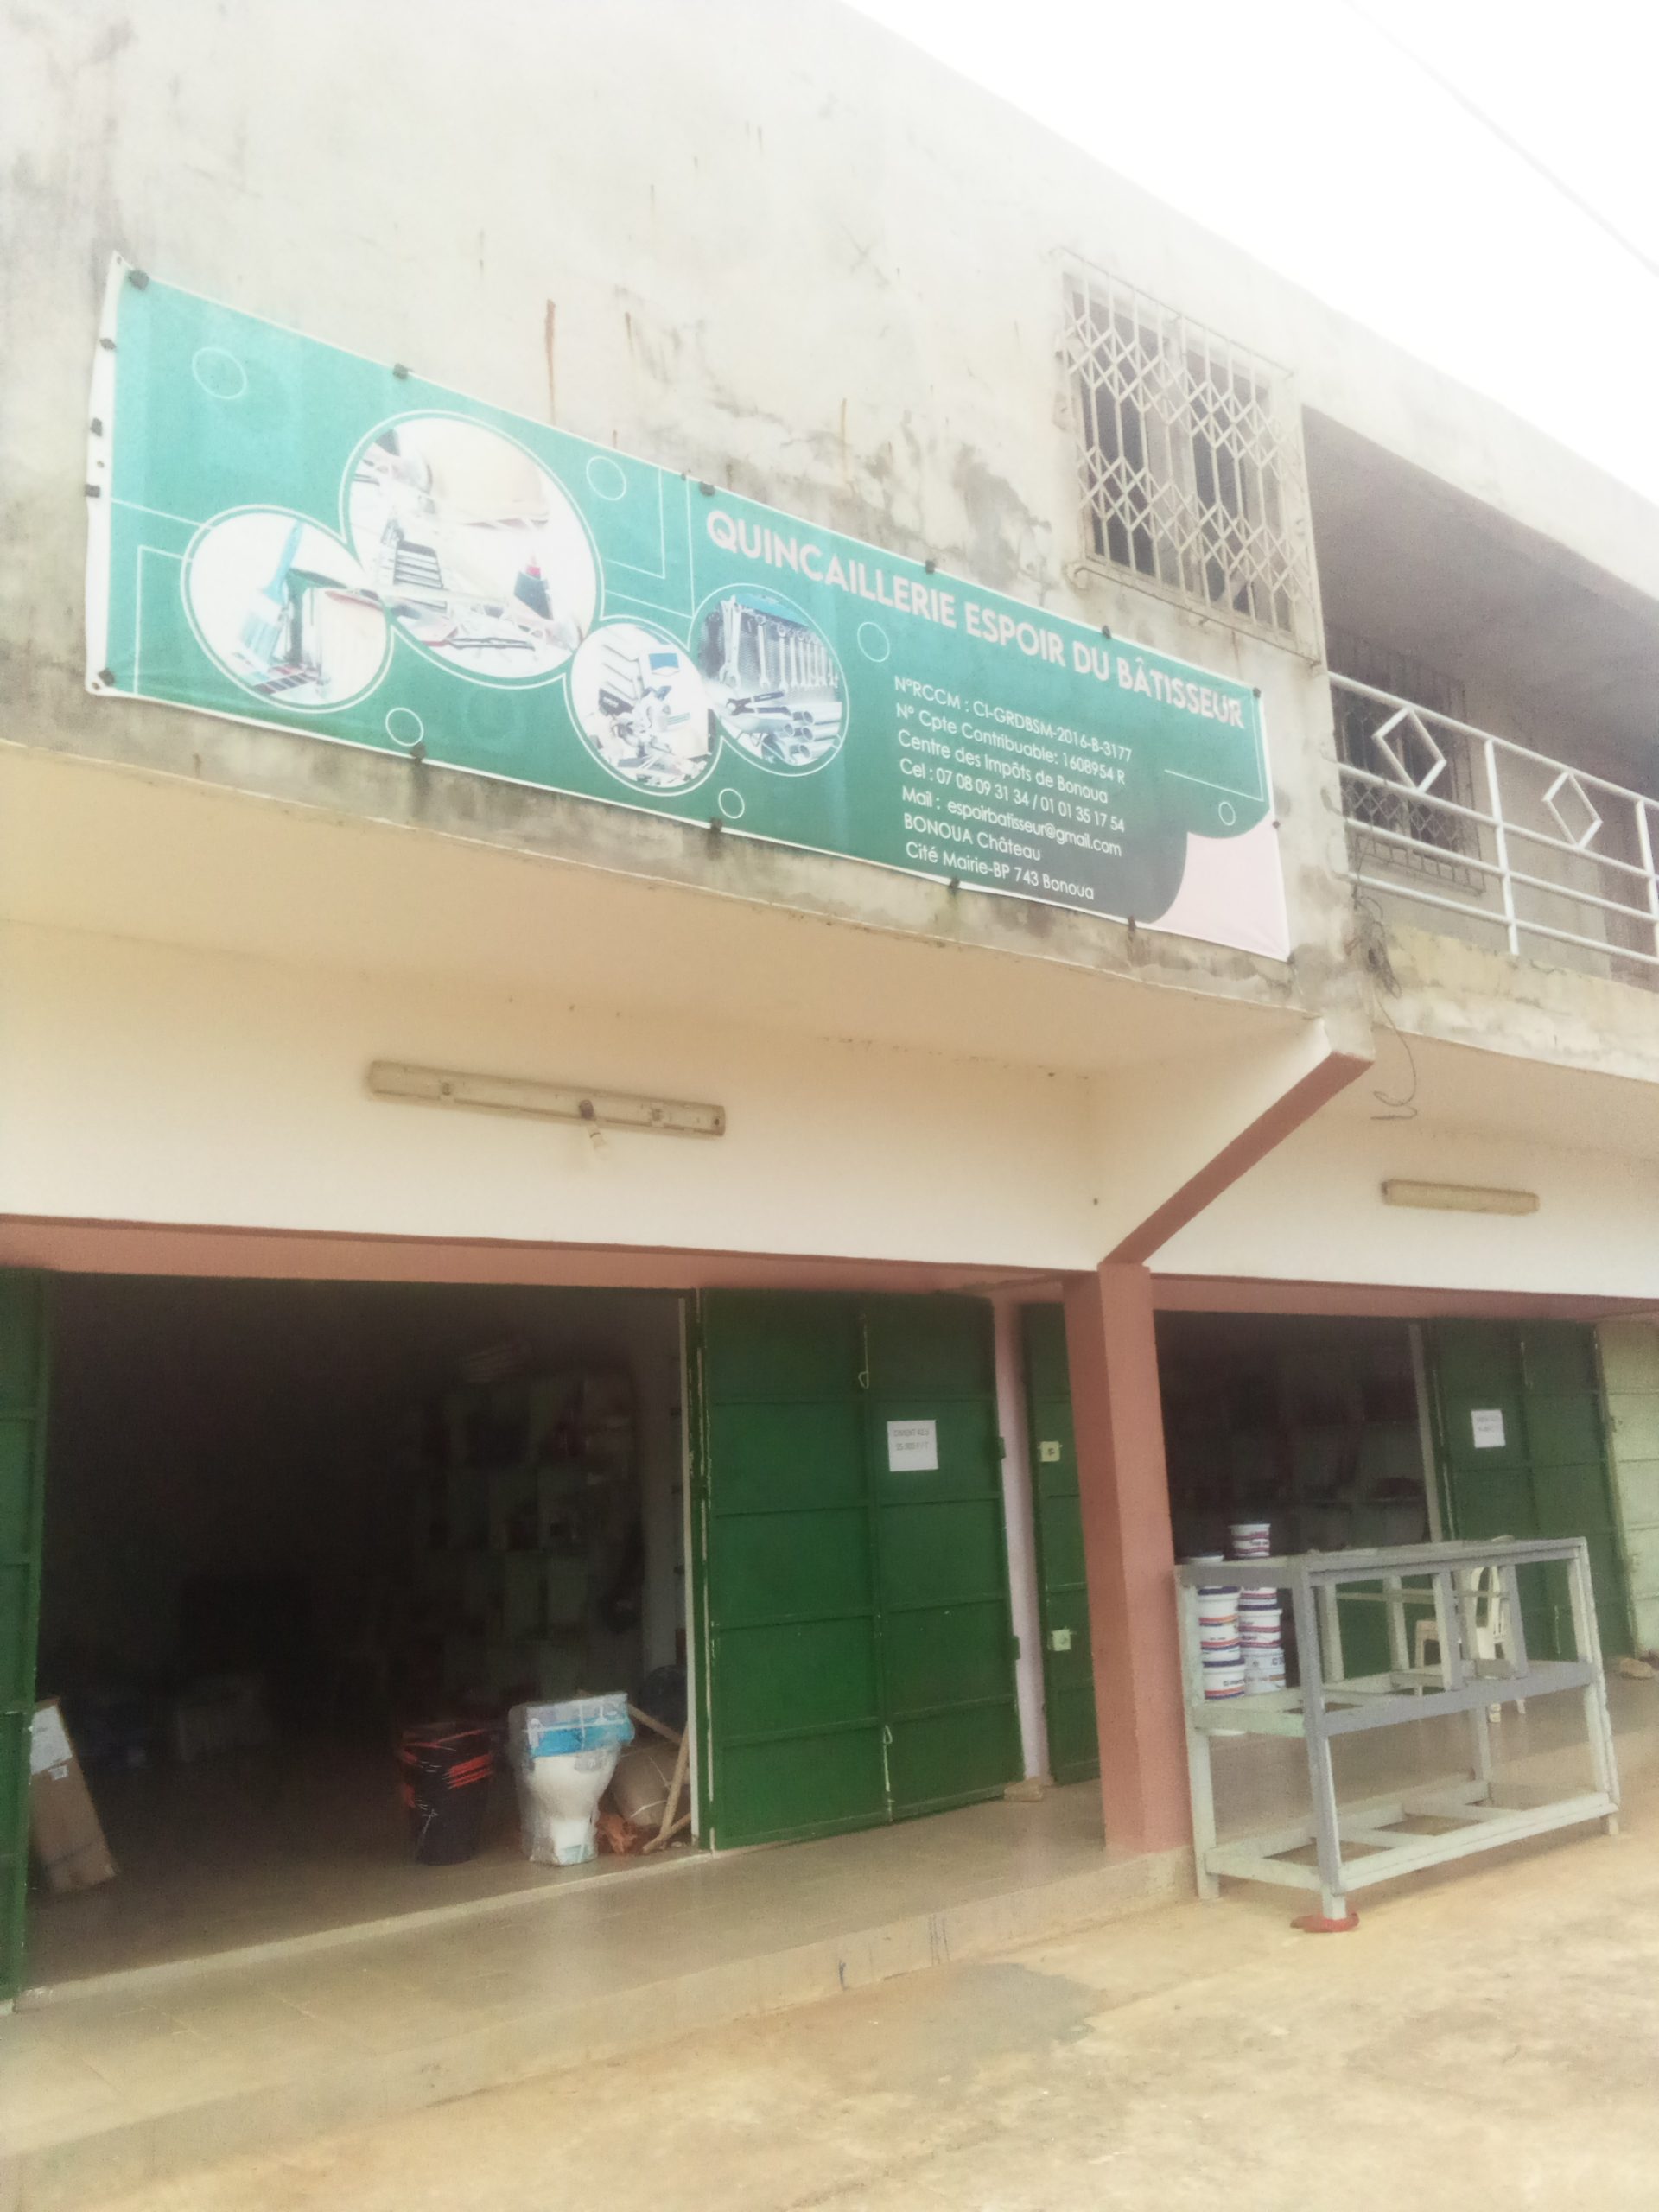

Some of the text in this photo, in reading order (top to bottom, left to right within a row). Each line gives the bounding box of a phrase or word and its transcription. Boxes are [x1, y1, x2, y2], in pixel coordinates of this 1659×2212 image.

[706, 510, 1245, 729] QUINCAILLERIE ESPOIR DU BÂTISSEUR
[898, 729, 1108, 804] Centre des Impôts de Bonoua
[918, 710, 957, 734] Cpte
[961, 723, 1058, 766] Contribuable:
[1063, 753, 1114, 781] 1608954
[1117, 769, 1126, 785] R
[899, 758, 925, 779] Cel
[936, 767, 952, 785] 07
[956, 773, 973, 791] 08
[976, 779, 991, 796] 09
[995, 784, 1009, 801] 31
[1013, 788, 1029, 806] 34
[1032, 794, 1038, 810] /
[1040, 796, 1054, 814] 01
[1058, 801, 1071, 818] 01
[1075, 806, 1090, 823] 35
[1094, 810, 1108, 827] 17
[1110, 816, 1126, 833] 54
[902, 785, 932, 807] Mail
[947, 800, 1122, 856] espoirbatisseur@gmail.com
[904, 812, 1041, 861] BONOUA Château
[906, 842, 1095, 900] Cité Mairie-BP 743 Bonoua
